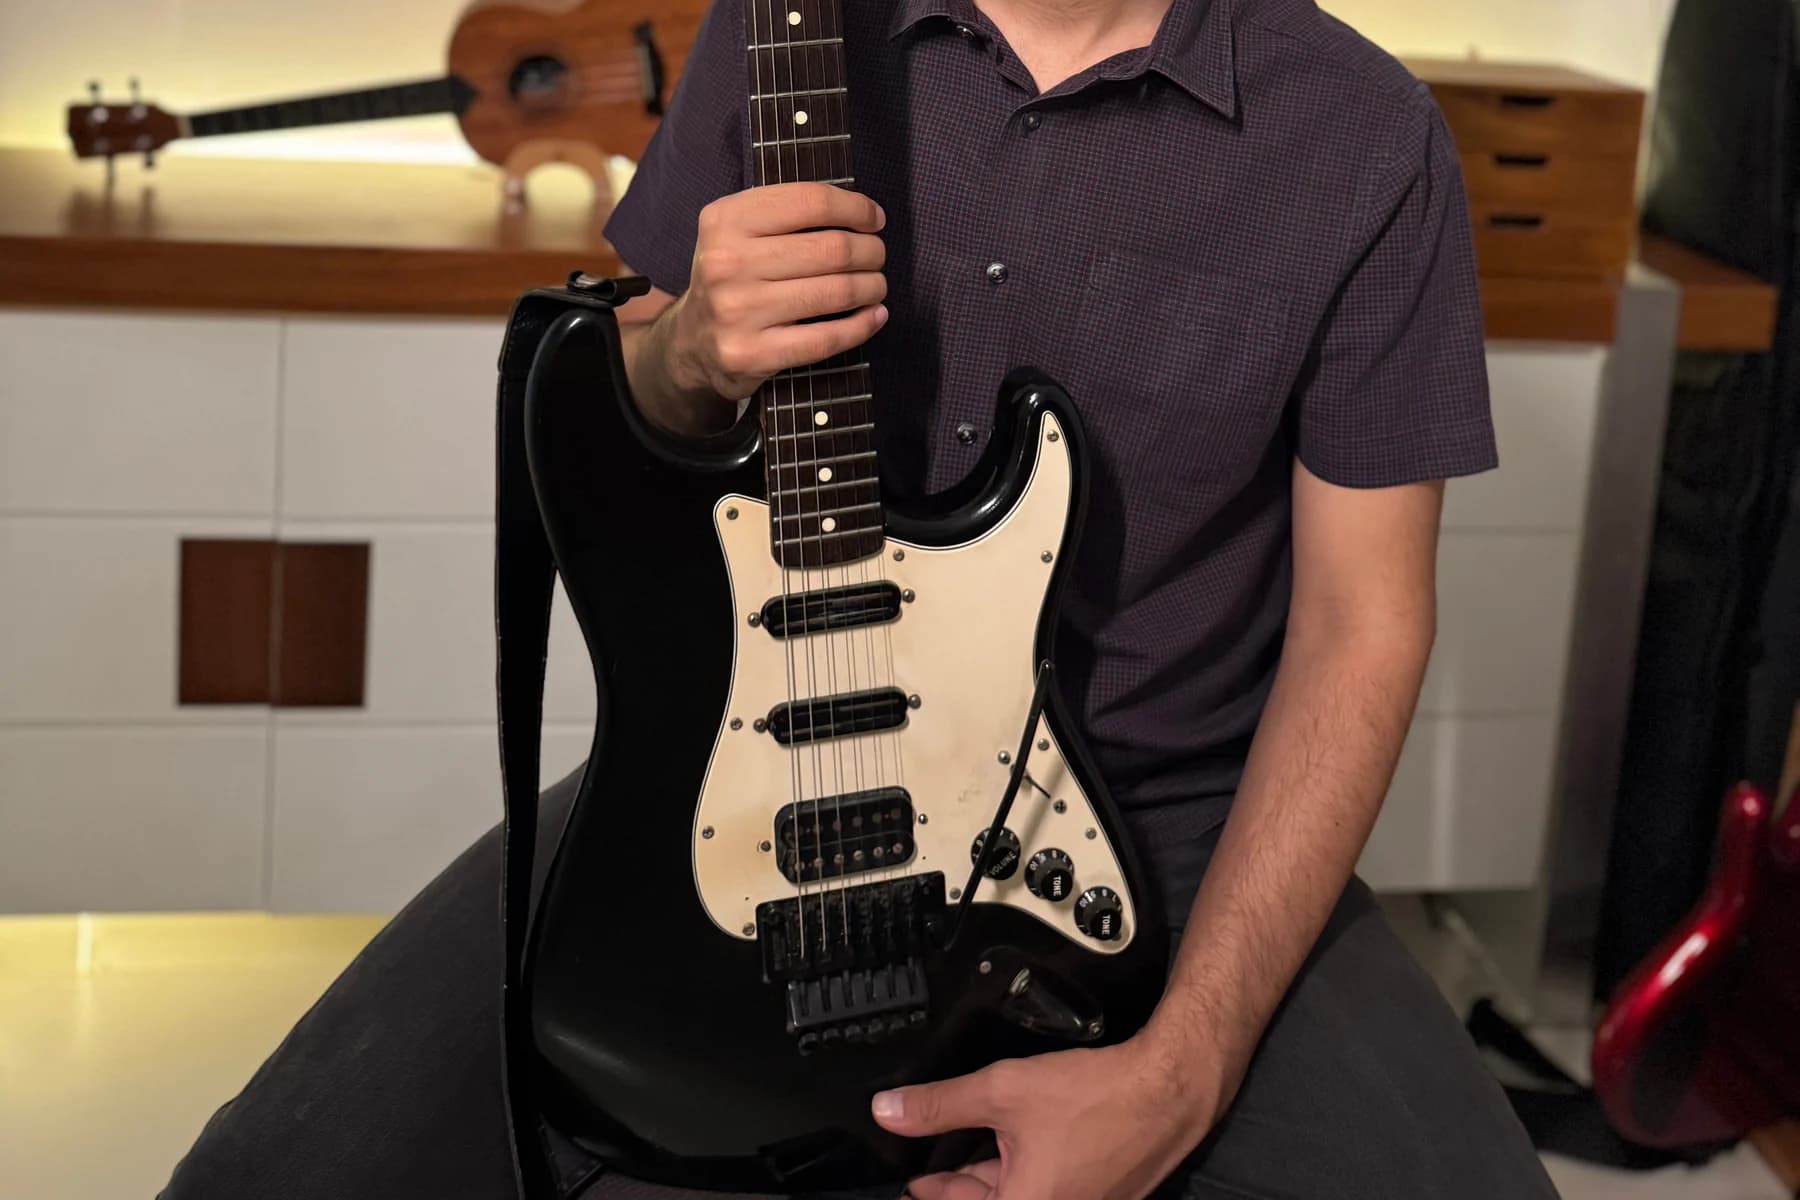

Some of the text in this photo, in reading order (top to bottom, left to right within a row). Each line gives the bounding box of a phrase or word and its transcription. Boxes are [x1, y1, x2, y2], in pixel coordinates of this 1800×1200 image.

[989, 850, 1017, 876] VOLUME
[1052, 875, 1062, 897] TONE
[1101, 914, 1111, 936] TONE
